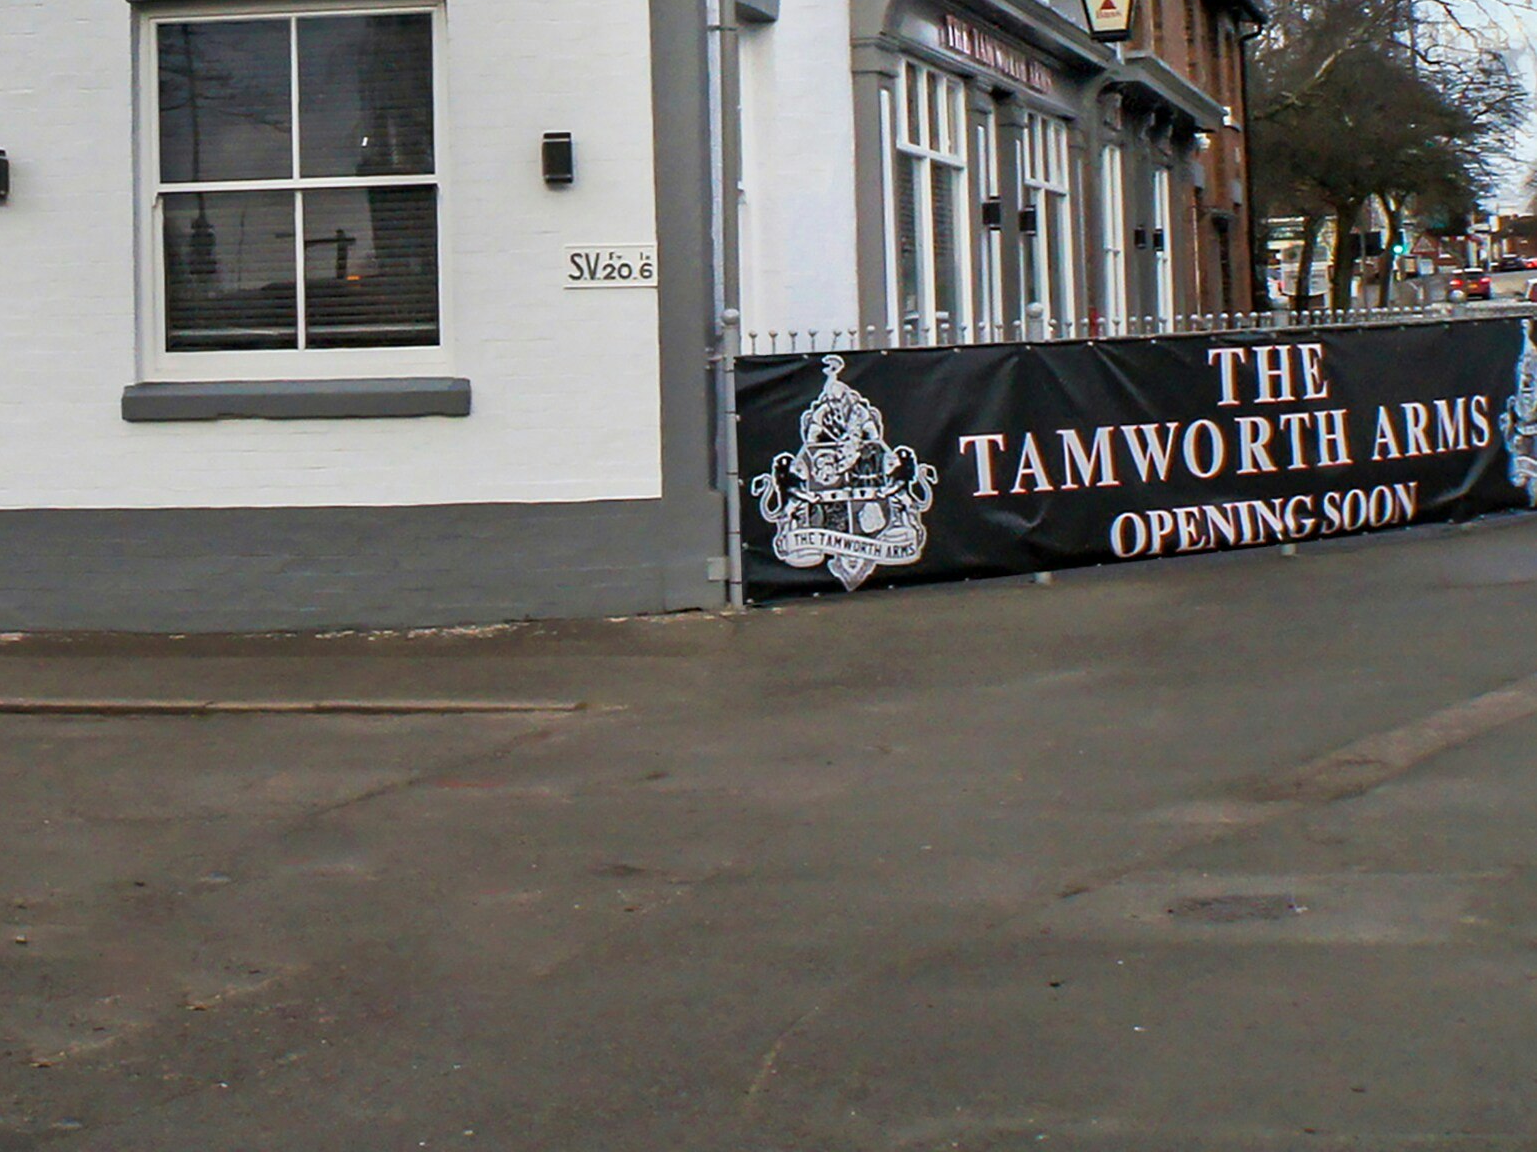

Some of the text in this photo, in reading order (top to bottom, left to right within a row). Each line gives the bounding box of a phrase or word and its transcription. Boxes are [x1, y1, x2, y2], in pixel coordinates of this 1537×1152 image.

[1208, 343, 1328, 406] THE
[959, 395, 1491, 497] TAMWORTH ARMS
[794, 532, 916, 559] THE TAMWORTH ARMS
[1111, 482, 1418, 559] OPENING SOON
